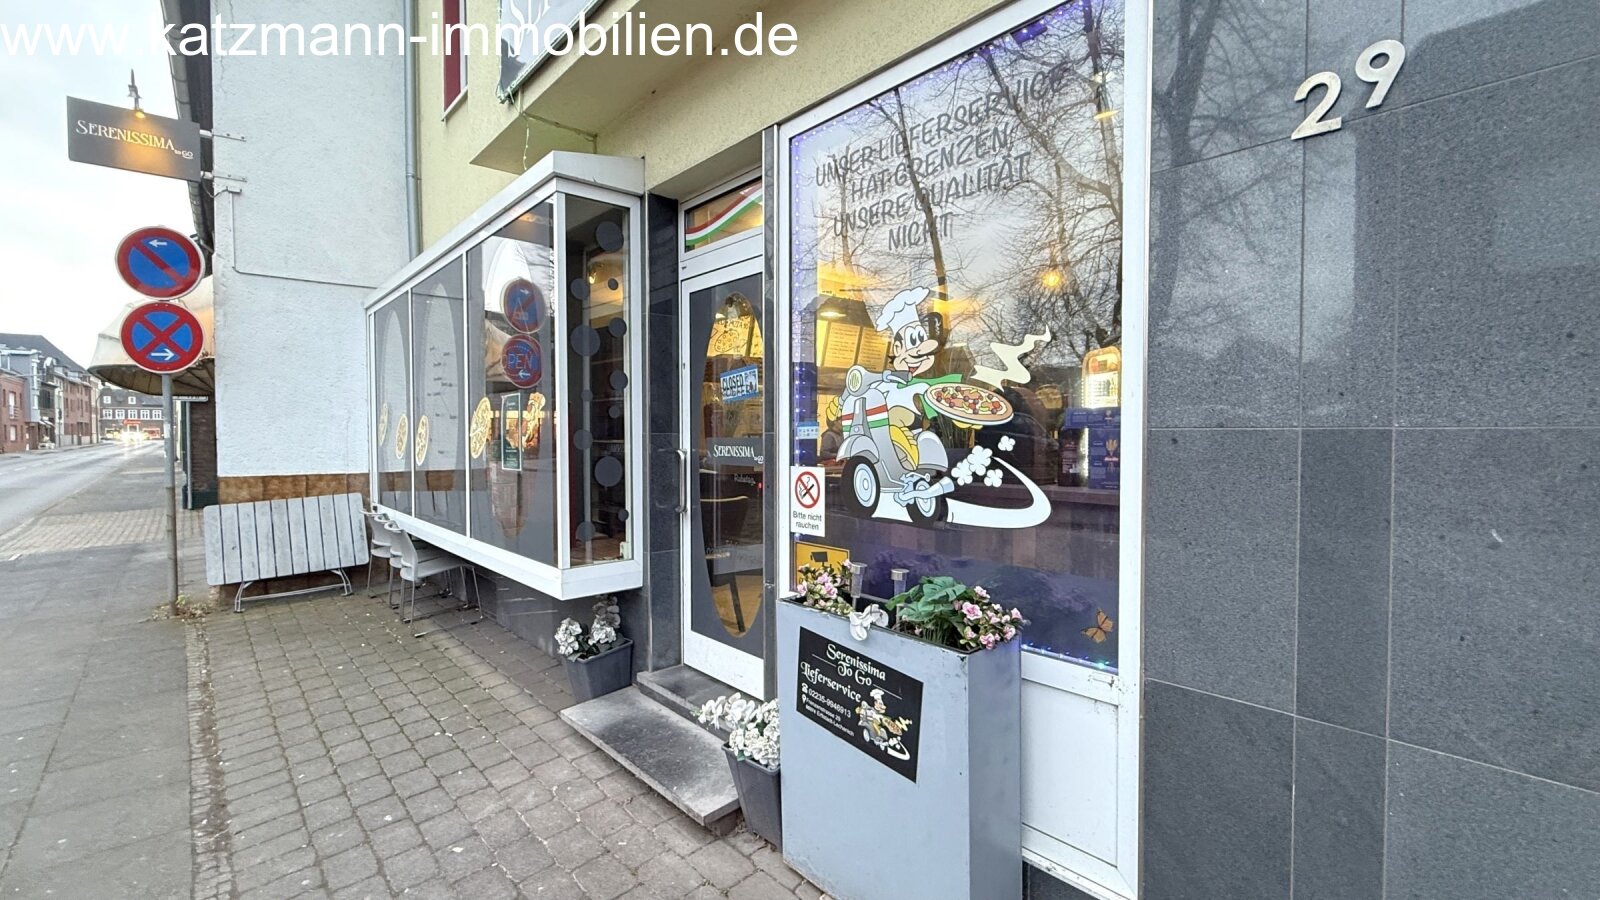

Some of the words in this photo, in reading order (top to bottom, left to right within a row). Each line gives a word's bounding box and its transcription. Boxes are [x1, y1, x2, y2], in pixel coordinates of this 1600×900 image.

[1291, 39, 1406, 140] 29
[75, 119, 175, 151] SERENISSIMA
[816, 144, 875, 187] UNSER
[851, 169, 889, 202] HAT
[894, 122, 1010, 186] GRENZEN
[834, 192, 908, 237] UNSERE
[915, 151, 1032, 211] QUALITÄT
[888, 212, 952, 251] NICHT
[713, 444, 755, 458] SERENISSIMA
[792, 510, 807, 520] Bitte
[807, 512, 823, 523] nicht
[795, 521, 820, 531] rauchen
[826, 643, 887, 681] Serenissima
[837, 660, 853, 677] To
[854, 669, 873, 687] Go
[800, 661, 862, 703] Lieferservice
